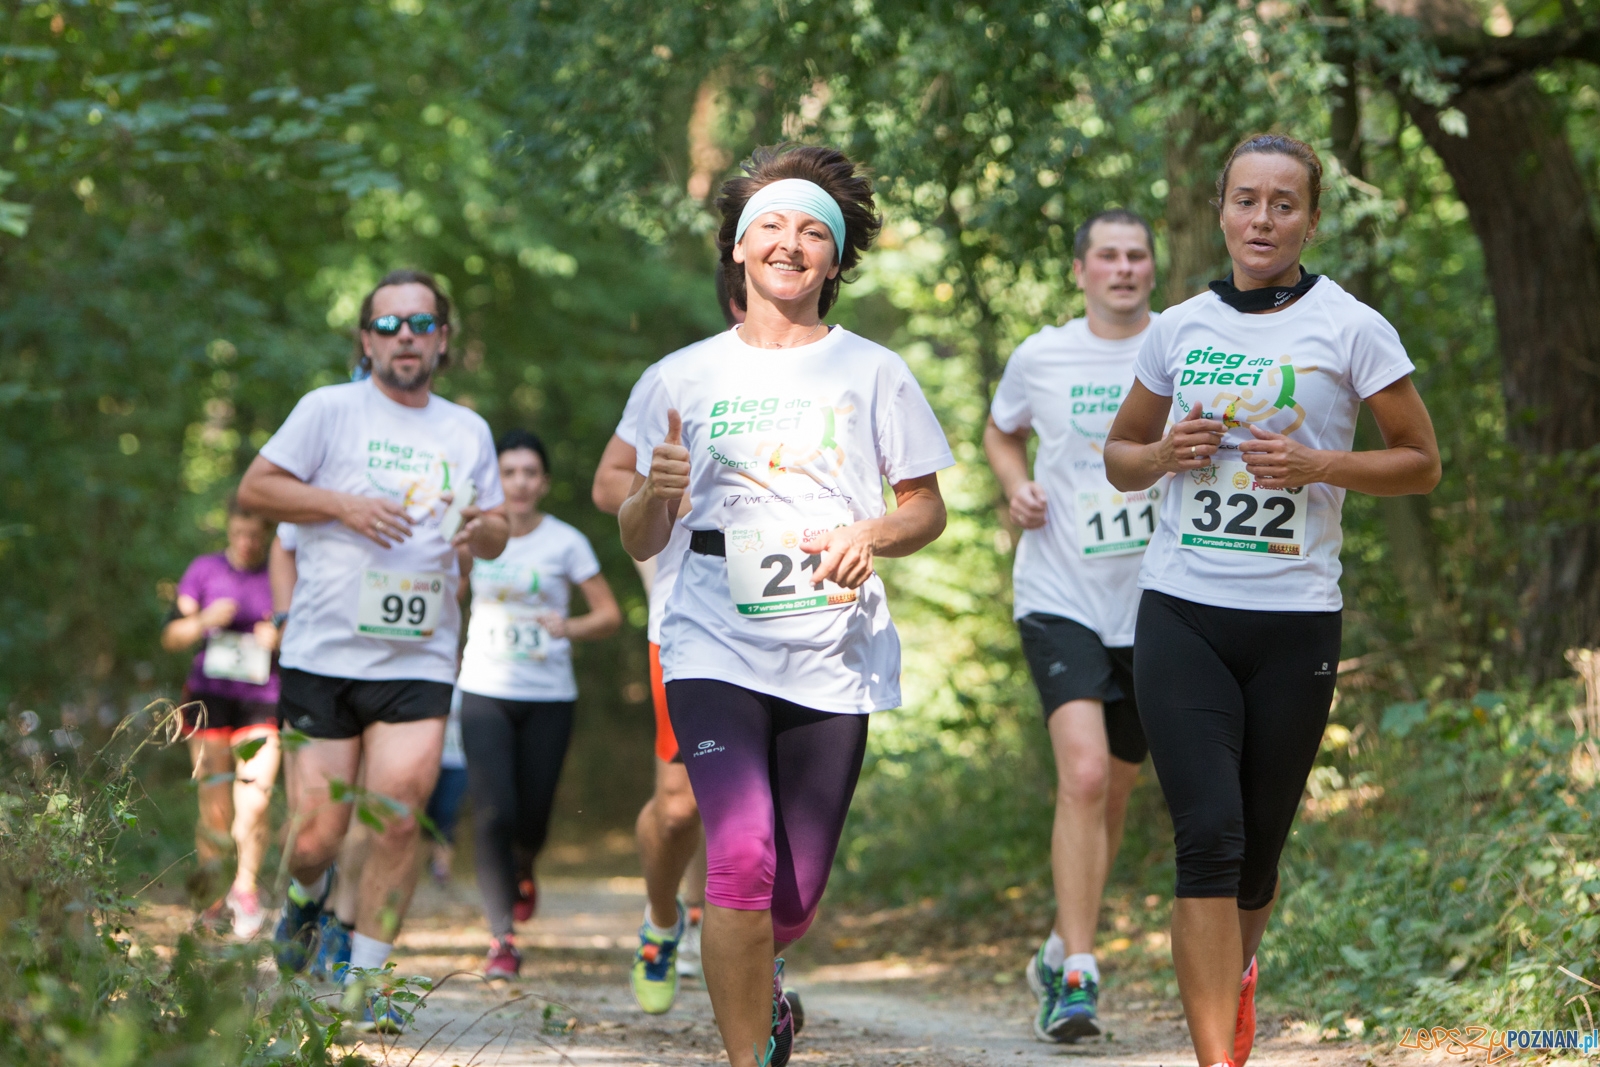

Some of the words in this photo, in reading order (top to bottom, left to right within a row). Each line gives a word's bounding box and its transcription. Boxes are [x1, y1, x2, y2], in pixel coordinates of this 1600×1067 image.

[1185, 346, 1247, 369] Bieg
[1247, 357, 1274, 366] dla
[1179, 367, 1264, 387] Dzieci
[1071, 383, 1121, 399] Bieg
[709, 396, 780, 418] Bieg
[784, 399, 811, 409] dla
[1176, 391, 1214, 419] Robta
[710, 411, 803, 439] Dzieci
[368, 439, 414, 459] Bieg
[707, 445, 758, 470] Roberta
[368, 457, 430, 473] Dzieci
[723, 495, 741, 507] 17
[1087, 503, 1155, 541] 111
[1191, 490, 1296, 539] 322
[1192, 537, 1203, 545] 17
[1233, 542, 1257, 550] 2016
[760, 553, 825, 598] 21
[382, 594, 426, 625] 99
[747, 605, 760, 613] 17
[794, 599, 817, 608] 2016
